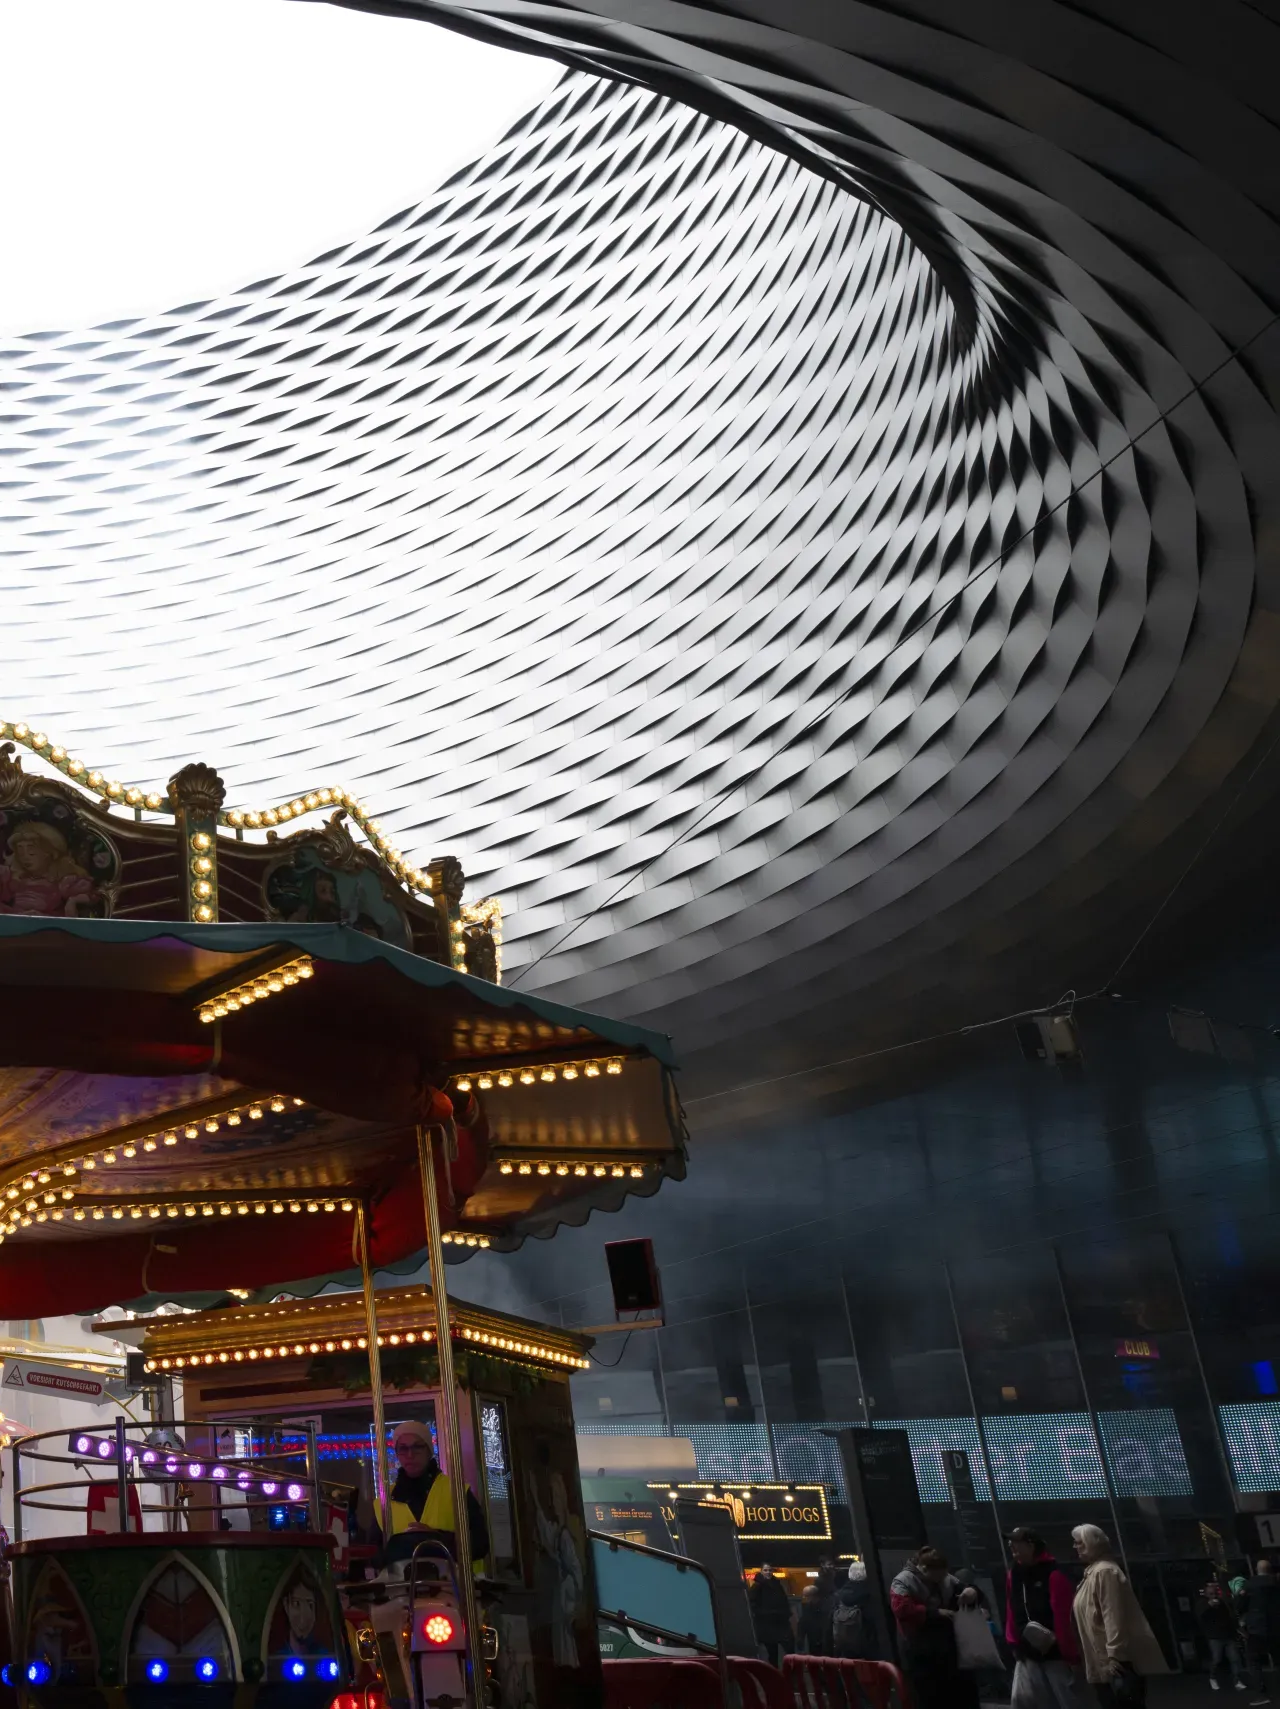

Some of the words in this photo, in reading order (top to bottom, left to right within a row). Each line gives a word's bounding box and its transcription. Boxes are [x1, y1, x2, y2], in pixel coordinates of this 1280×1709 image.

[1124, 1340, 1151, 1356] CLUB
[29, 1373, 55, 1386] VORSICHT
[952, 1452, 964, 1469] D
[747, 1507, 777, 1522] HOT
[781, 1507, 820, 1522] DOGS
